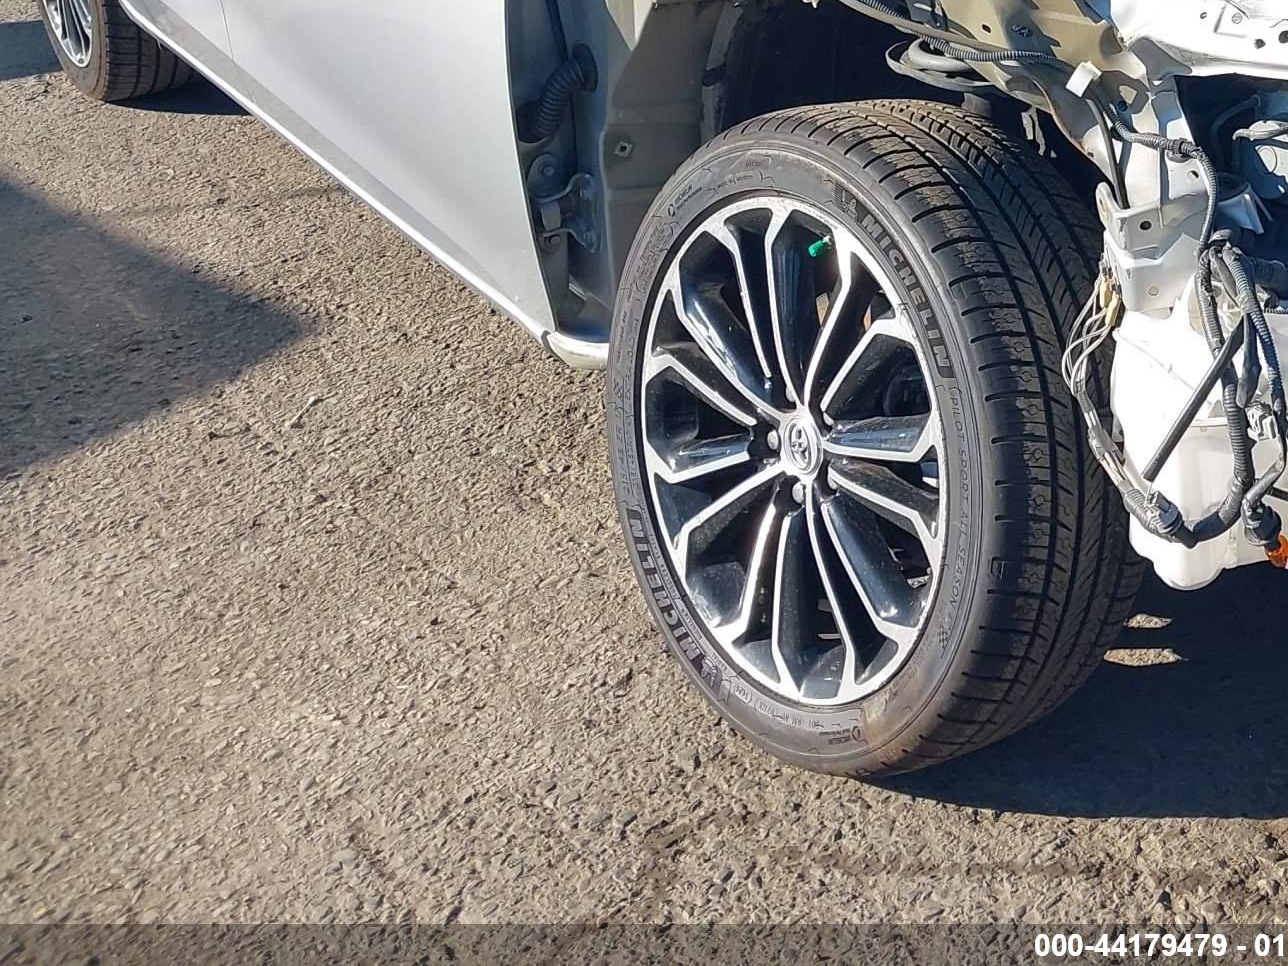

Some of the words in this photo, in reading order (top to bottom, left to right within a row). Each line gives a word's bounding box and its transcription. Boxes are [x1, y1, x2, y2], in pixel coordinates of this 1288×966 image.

[861, 215, 950, 367] MICHELIN
[951, 397, 965, 442] PILOT
[960, 449, 969, 505] SPORT
[629, 519, 701, 661] MICHELIN
[949, 546, 966, 608] SEASON
